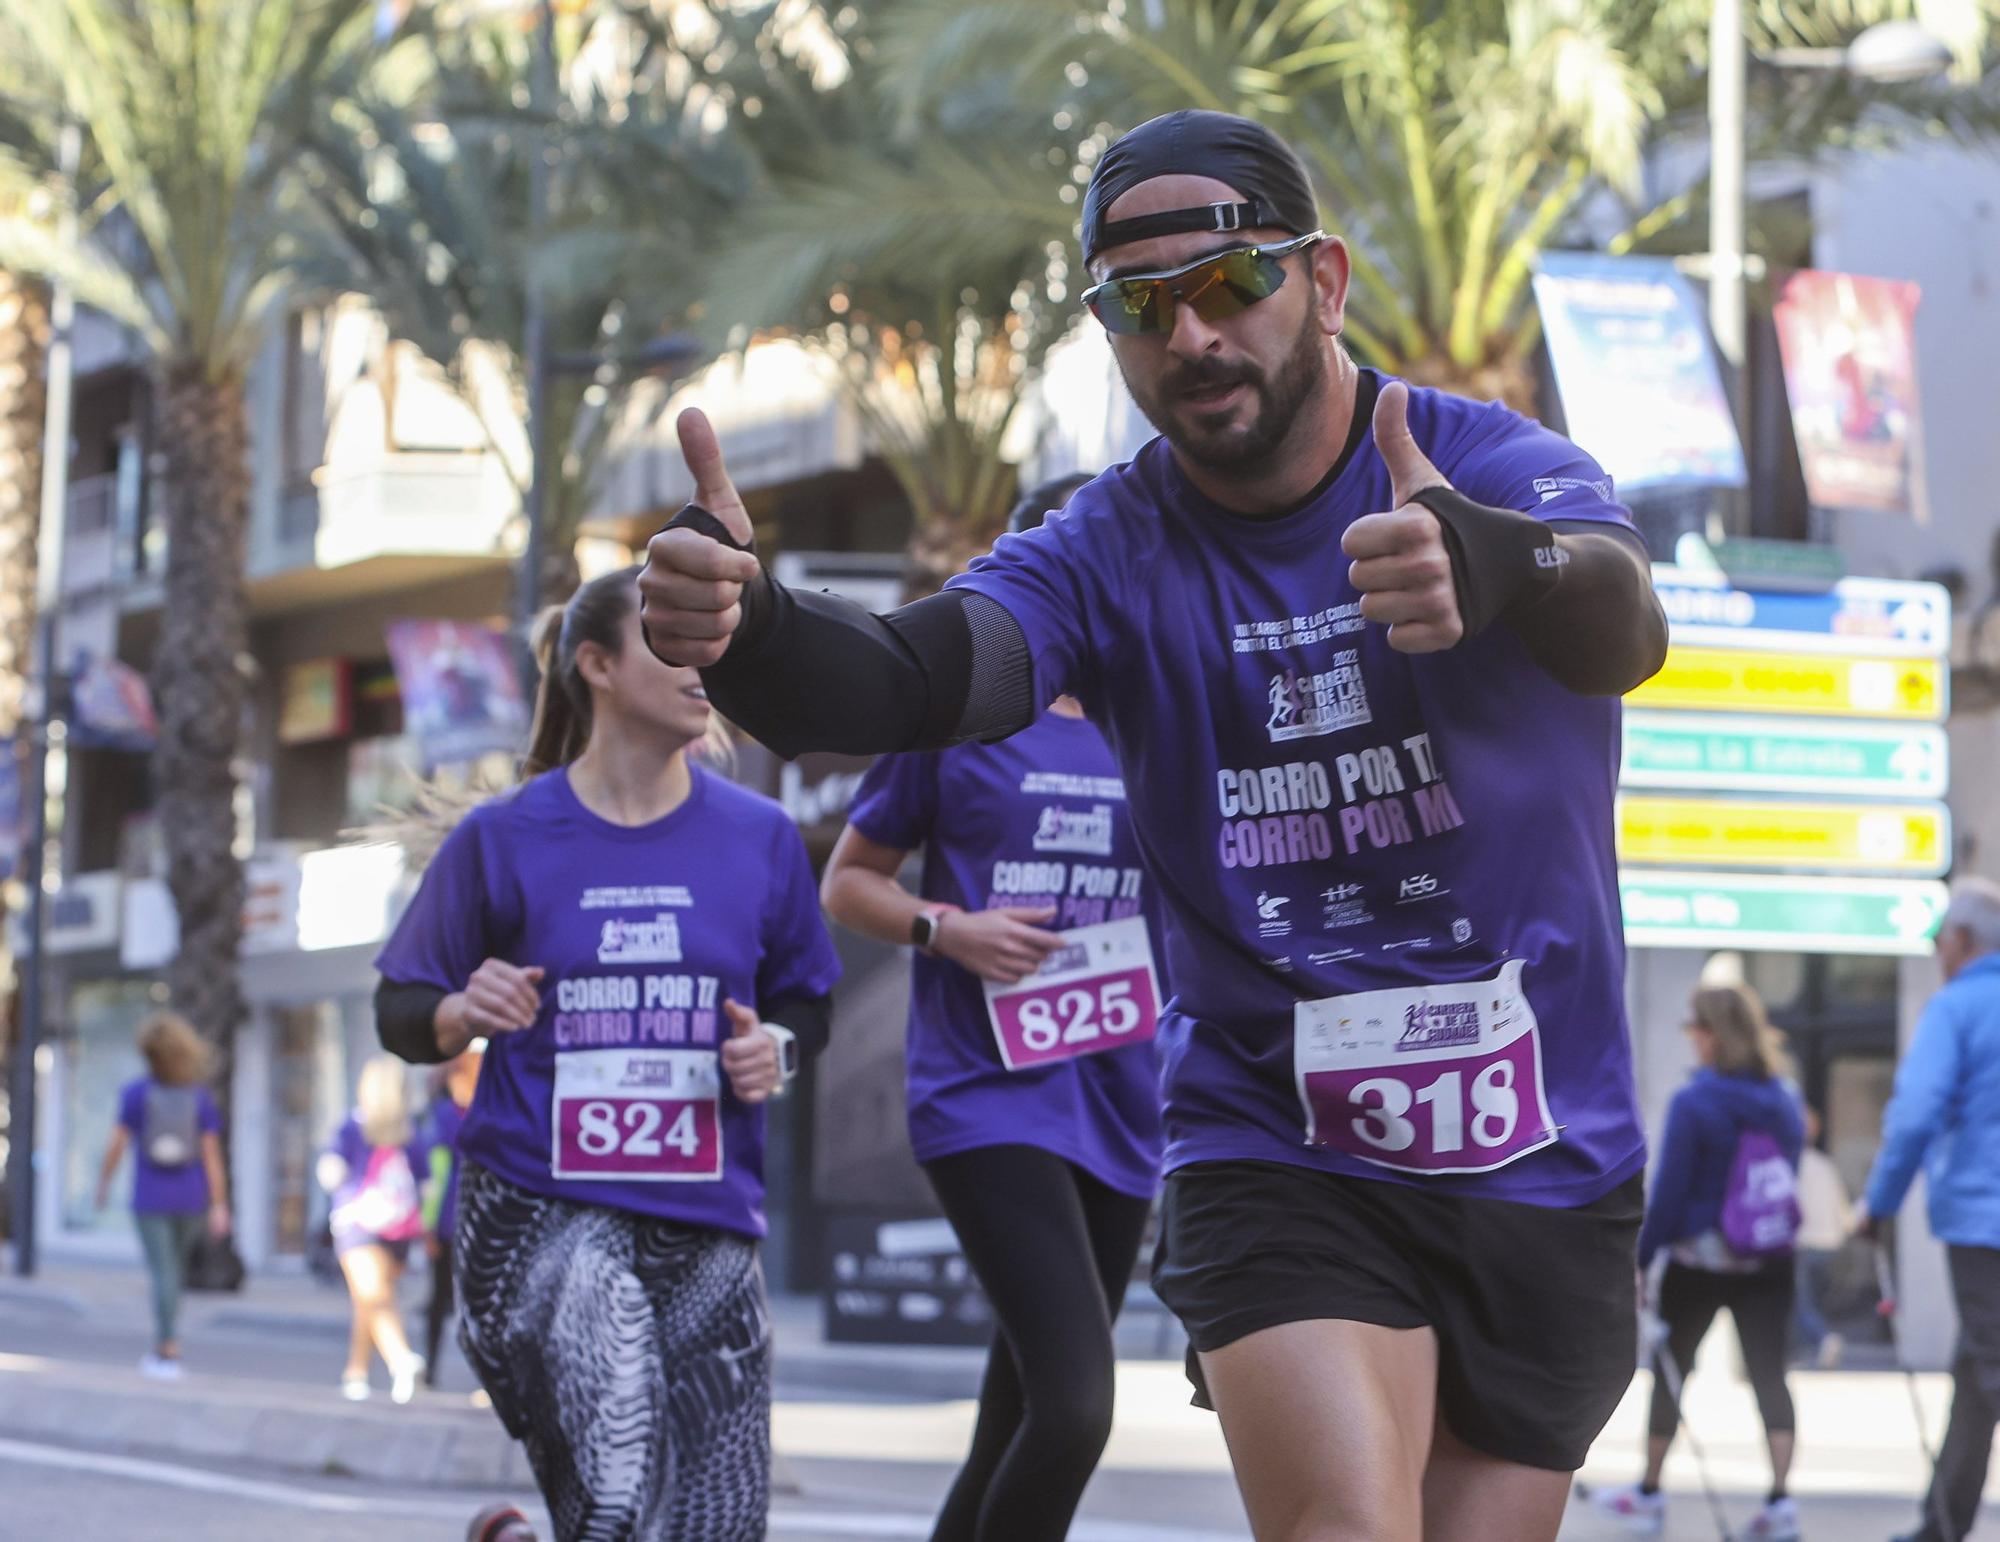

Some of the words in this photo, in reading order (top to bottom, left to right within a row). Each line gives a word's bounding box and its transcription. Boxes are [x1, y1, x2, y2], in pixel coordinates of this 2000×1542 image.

[1292, 616, 1309, 631] DE
[1268, 636, 1282, 650] EL
[1314, 687, 1337, 708] DE
[1217, 761, 1332, 818] CORRO
[1335, 745, 1406, 803] POR
[1219, 813, 1332, 869] CORRO
[1339, 798, 1413, 854] POR
[992, 861, 1065, 894] CORRO
[1069, 864, 1118, 898] POR
[1119, 868, 1142, 899] TI
[557, 976, 638, 1011] CORRO
[644, 975, 694, 1009] POR
[698, 976, 719, 1008] TI
[1428, 1001, 1477, 1017] CARRERA
[554, 1009, 632, 1045] CORRO
[639, 1010, 687, 1043] POR
[691, 1010, 717, 1043] MI
[1018, 980, 1140, 1051] 825
[1445, 1015, 1457, 1028] DE
[1348, 1059, 1519, 1153] 318
[577, 1102, 700, 1156] 824
